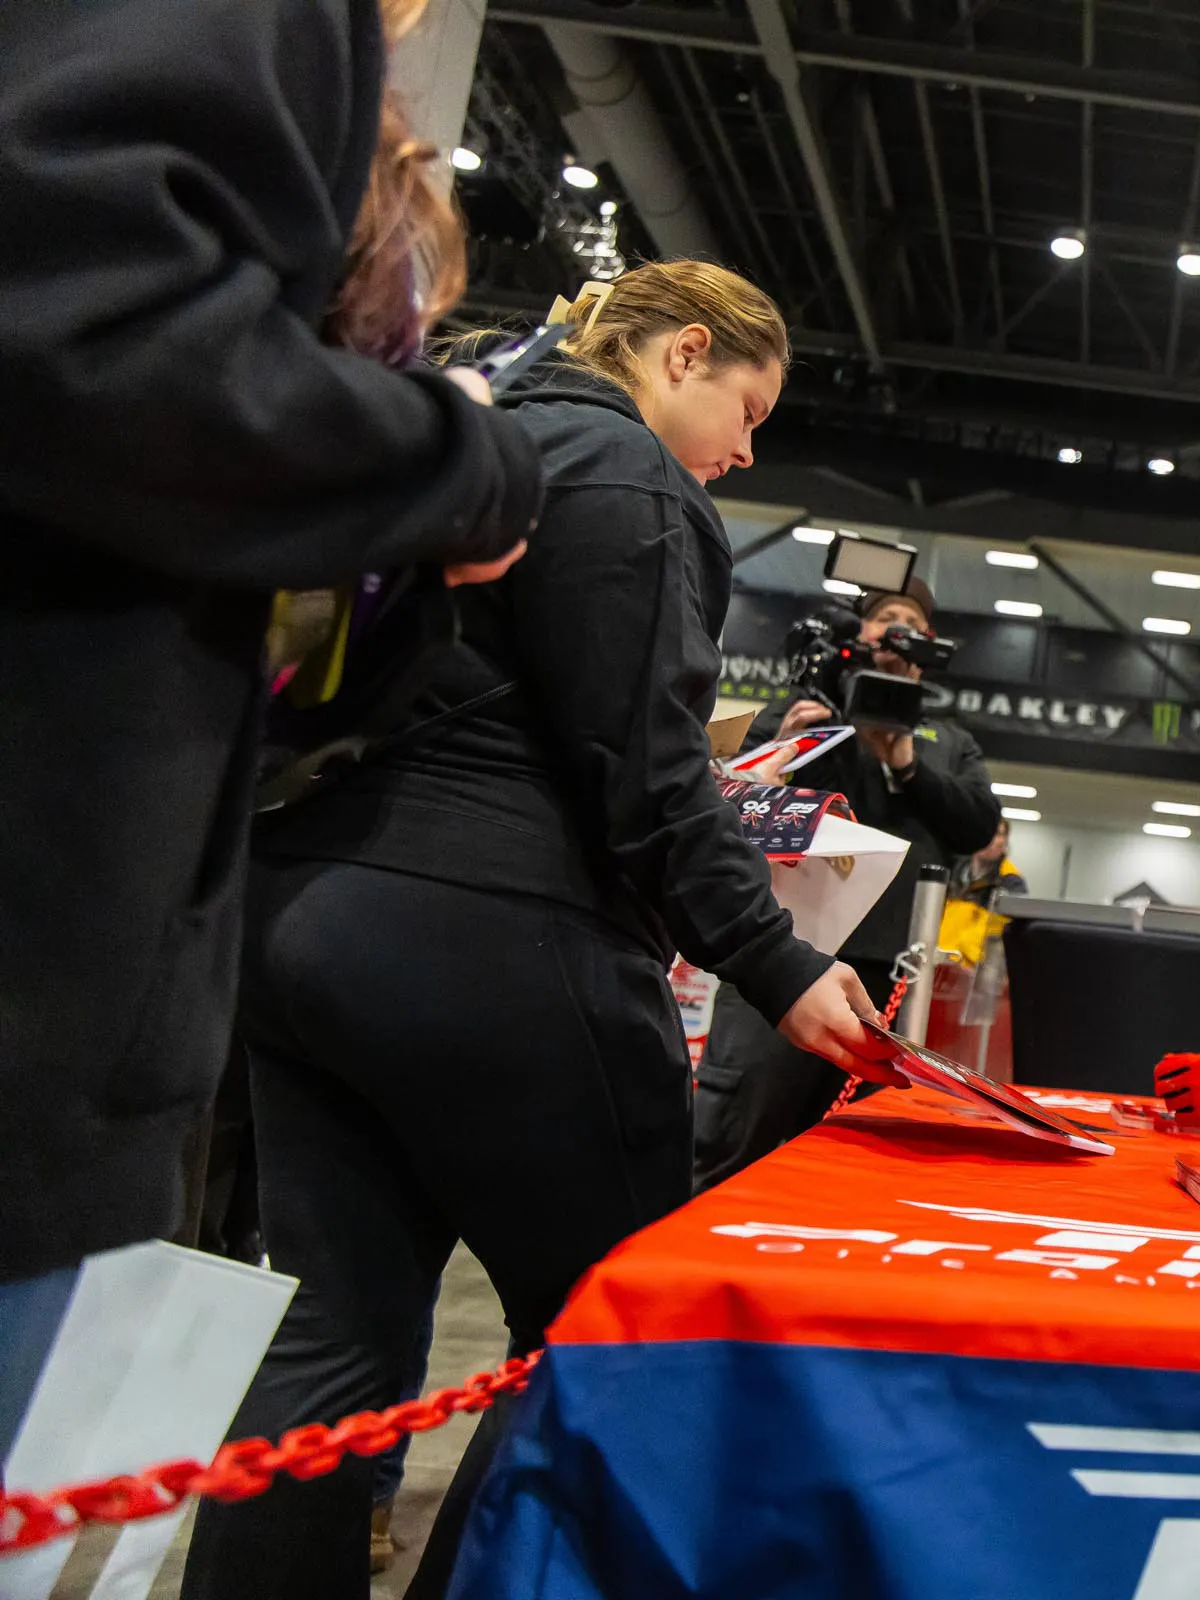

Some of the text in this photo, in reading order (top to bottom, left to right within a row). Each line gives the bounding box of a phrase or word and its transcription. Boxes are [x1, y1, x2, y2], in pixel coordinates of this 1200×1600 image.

[958, 690, 1126, 729] OAKLEY
[742, 800, 771, 814] 96
[782, 802, 819, 814] 29
